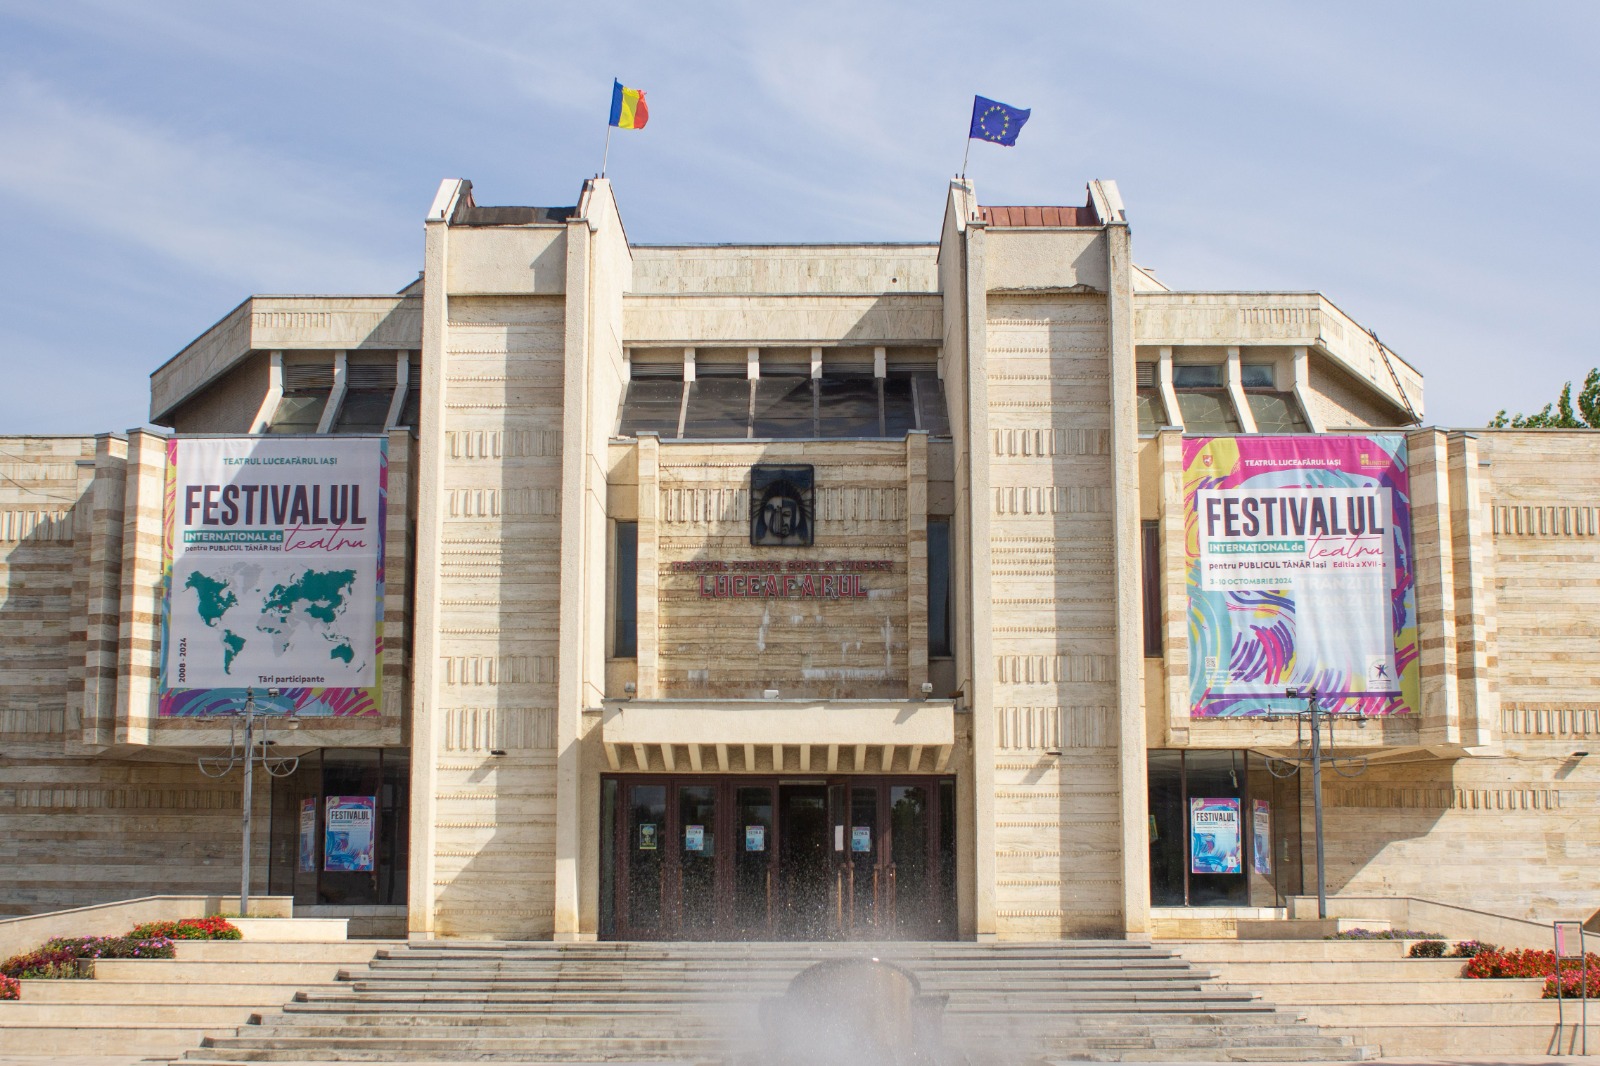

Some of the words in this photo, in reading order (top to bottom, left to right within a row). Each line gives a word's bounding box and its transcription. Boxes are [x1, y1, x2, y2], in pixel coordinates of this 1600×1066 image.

[223, 457, 261, 465] TEATRUL
[263, 456, 319, 465] LUCEAFĂRUL
[320, 457, 337, 466] IAȘI
[1245, 459, 1277, 467] TEATRUL
[1278, 458, 1325, 466] LUCEAFĂRUL
[1326, 459, 1341, 467] IAȘI
[184, 484, 367, 525] FESTIVALUL
[1206, 495, 1384, 536] FESTIVALUL
[185, 532, 267, 542] INTERNAȚIONAL
[269, 531, 282, 541] de
[1209, 542, 1290, 553] INTERNAȚIONAL
[1291, 543, 1304, 551] de
[1209, 562, 1237, 570] pentru
[1238, 561, 1281, 569] PUBLICUL
[179, 637, 187, 657] 2024
[178, 663, 186, 683] 2008
[275, 675, 325, 684] participante
[331, 810, 370, 820] FESTIVALUL
[1196, 812, 1235, 822] FESTIVALUL
